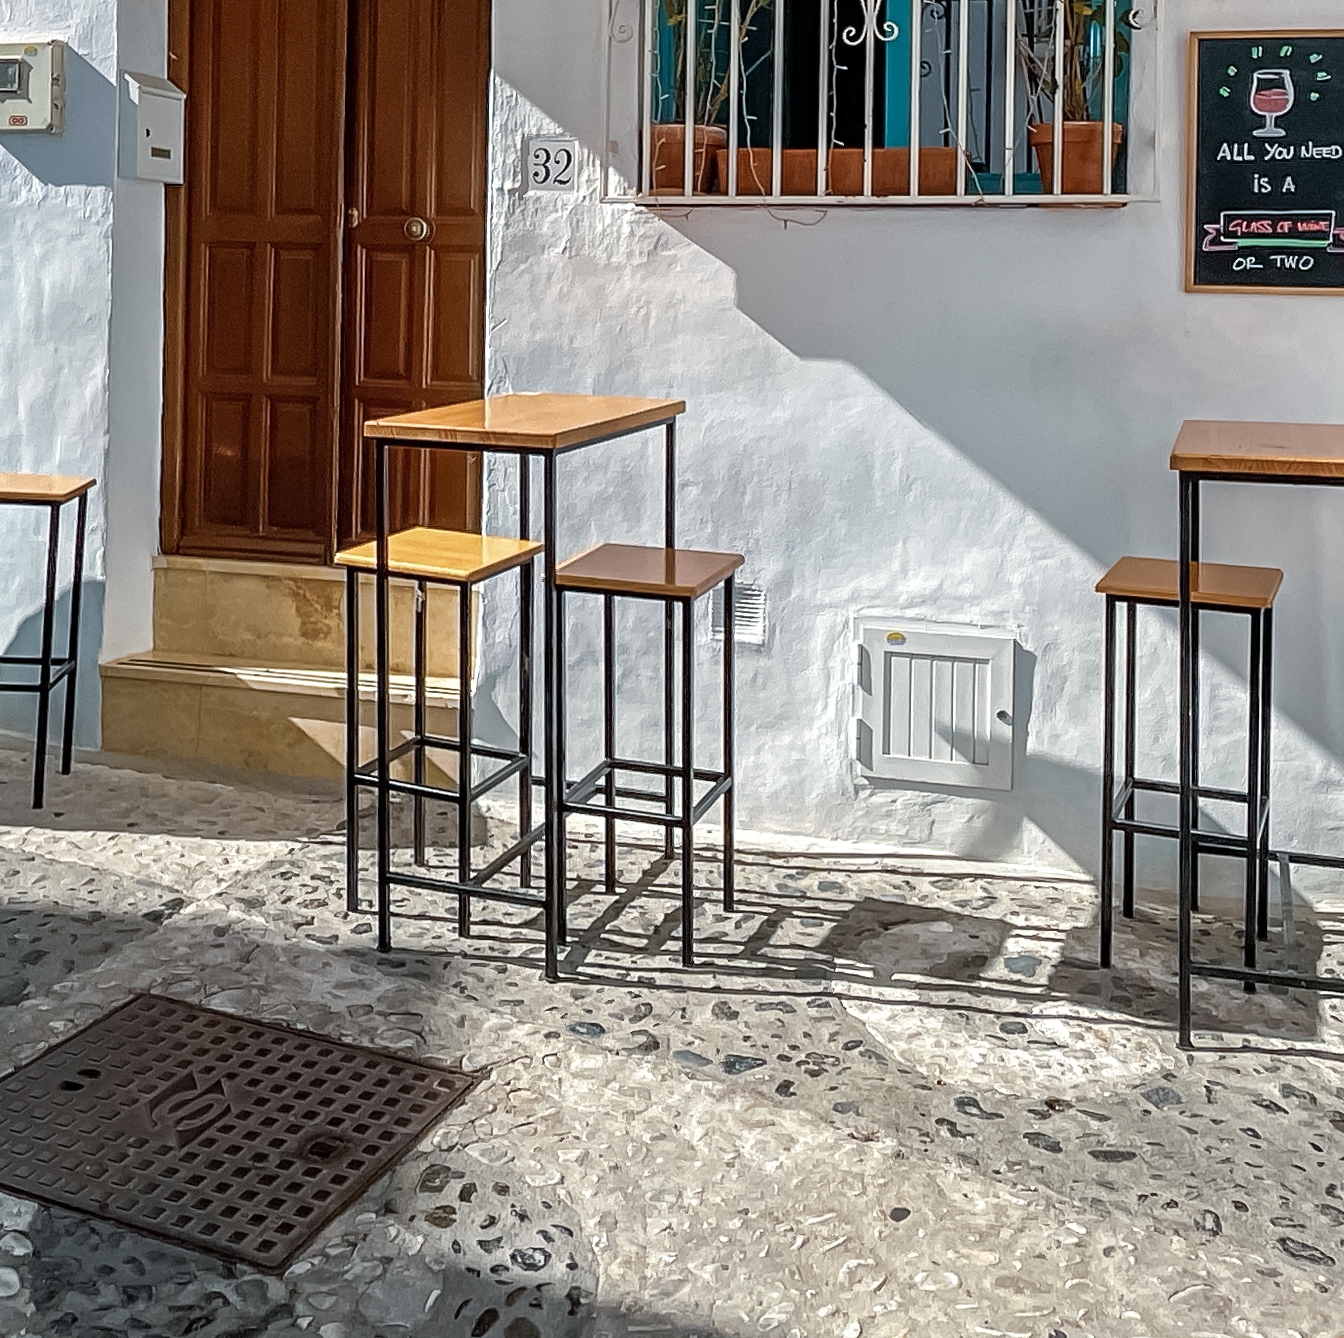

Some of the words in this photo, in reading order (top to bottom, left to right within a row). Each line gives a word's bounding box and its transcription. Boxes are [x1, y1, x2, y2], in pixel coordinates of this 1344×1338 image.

[1216, 142, 1255, 161] ALL
[1300, 141, 1343, 159] NEED
[532, 147, 573, 185] 32
[1282, 176, 1296, 193] A
[1228, 219, 1273, 237] GLASS
[1276, 220, 1293, 234] OF
[1232, 256, 1264, 271] OR
[1269, 254, 1315, 271] TWO
